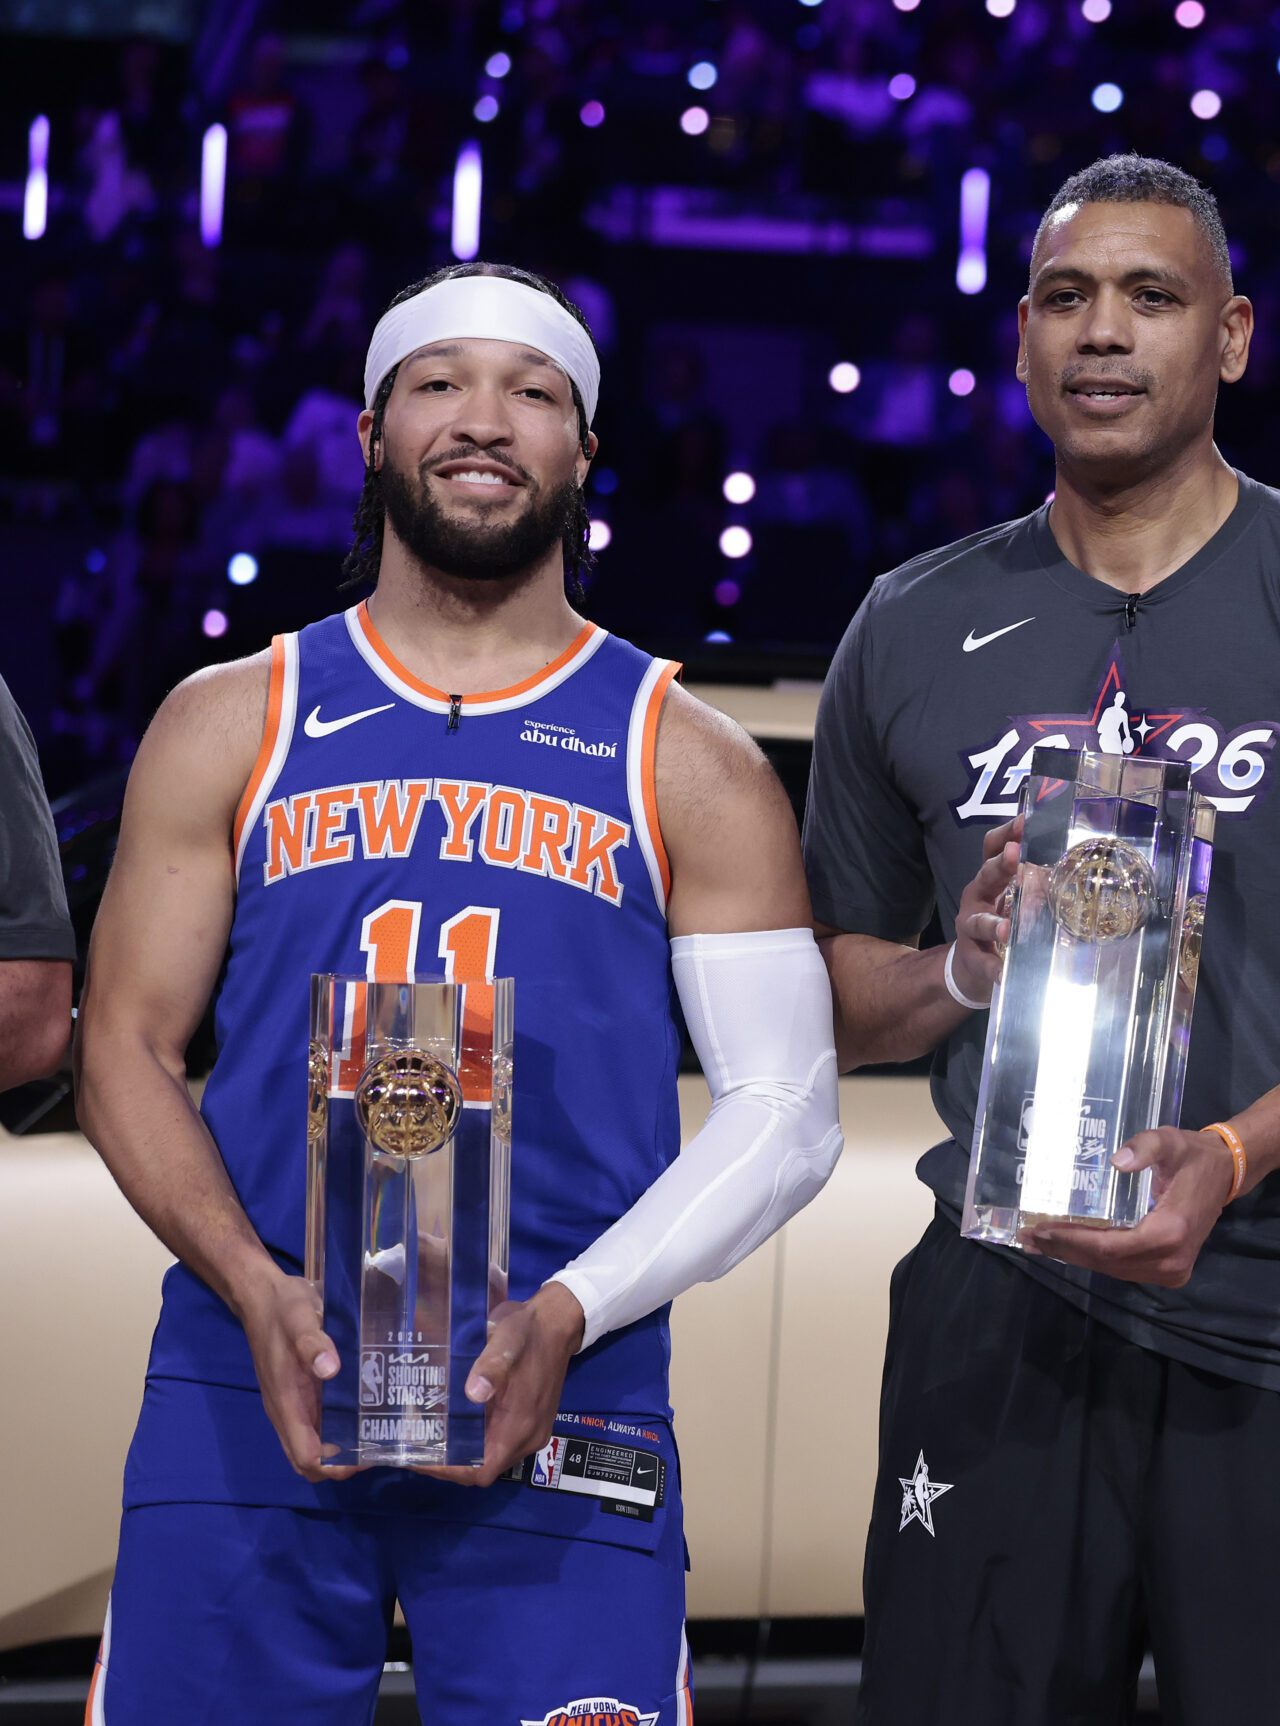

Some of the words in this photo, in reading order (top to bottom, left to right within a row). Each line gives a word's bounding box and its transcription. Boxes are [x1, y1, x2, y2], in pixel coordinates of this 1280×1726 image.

[524, 718, 576, 736] experience
[520, 727, 559, 748] abu
[263, 778, 433, 887] NEW
[432, 778, 631, 908] YORK
[388, 1366, 446, 1386] SHOOTING
[387, 1386, 425, 1406] STARS
[360, 1418, 444, 1441] CHAMPIONS
[555, 1413, 573, 1423] NCE
[573, 1414, 580, 1424] A
[608, 1421, 636, 1435] ALWAYS
[635, 1428, 642, 1437] A
[568, 1452, 582, 1464] 48
[590, 1445, 633, 1459] ENGINEERED
[534, 1474, 545, 1483] NBA
[570, 1703, 591, 1716] NEW
[593, 1702, 618, 1713] YORK
